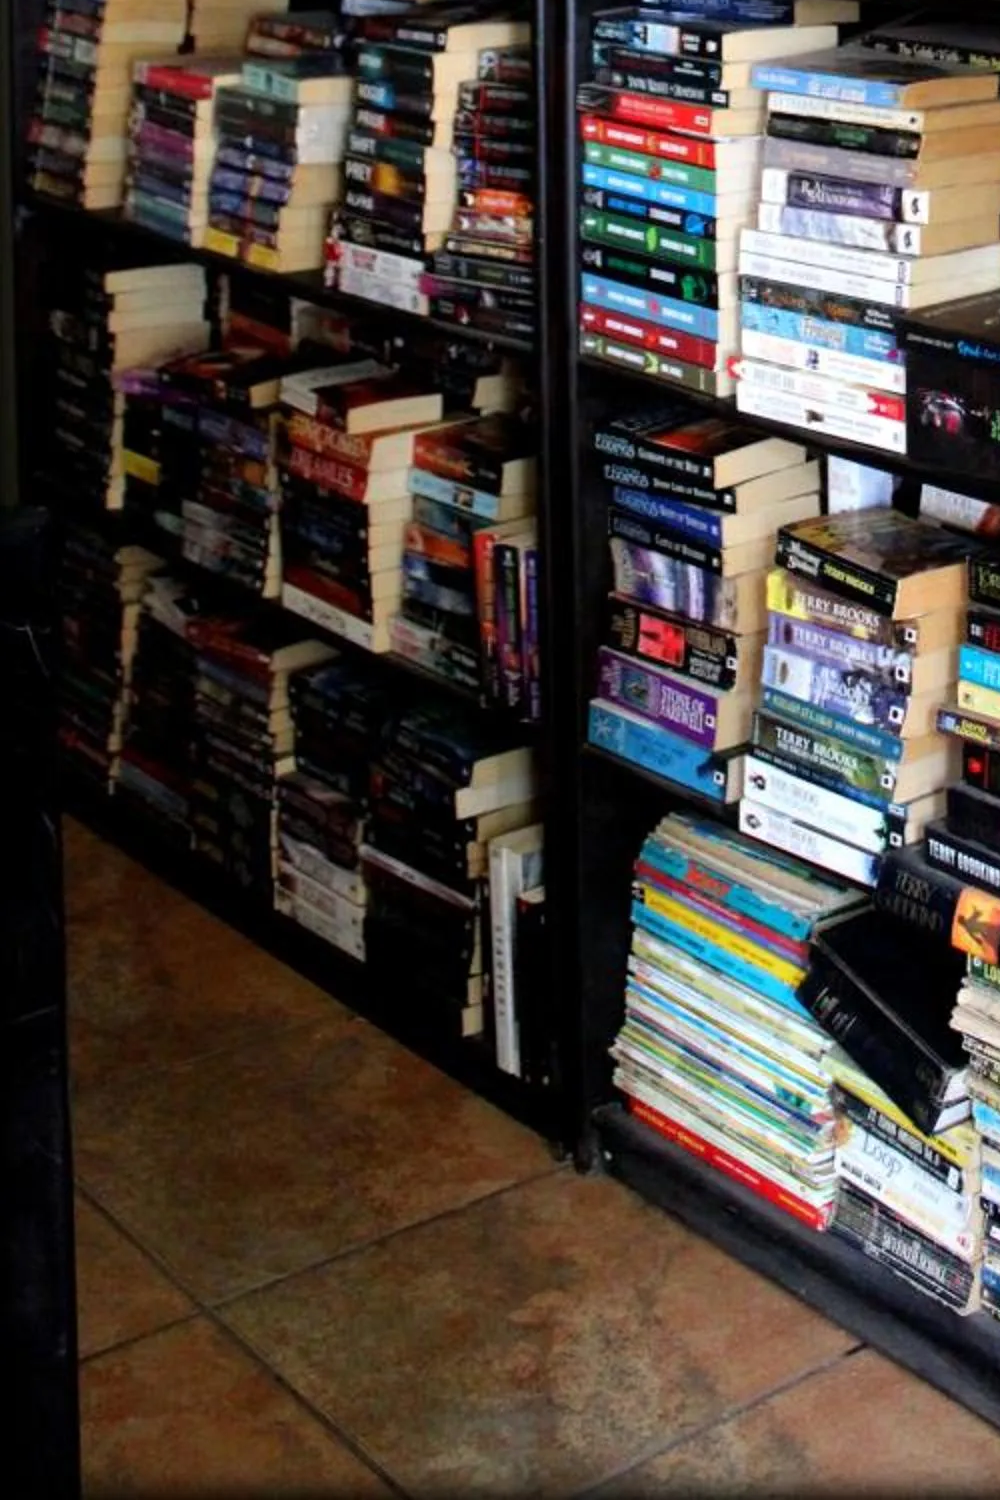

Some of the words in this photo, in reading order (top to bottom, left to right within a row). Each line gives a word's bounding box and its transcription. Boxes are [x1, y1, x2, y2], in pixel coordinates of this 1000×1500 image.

[832, 599, 880, 627] BROOKS
[775, 726, 811, 751] TERRY
[812, 740, 860, 770] BROOKS
[928, 838, 955, 865] TERRY
[956, 852, 1000, 888] GOODKIND
